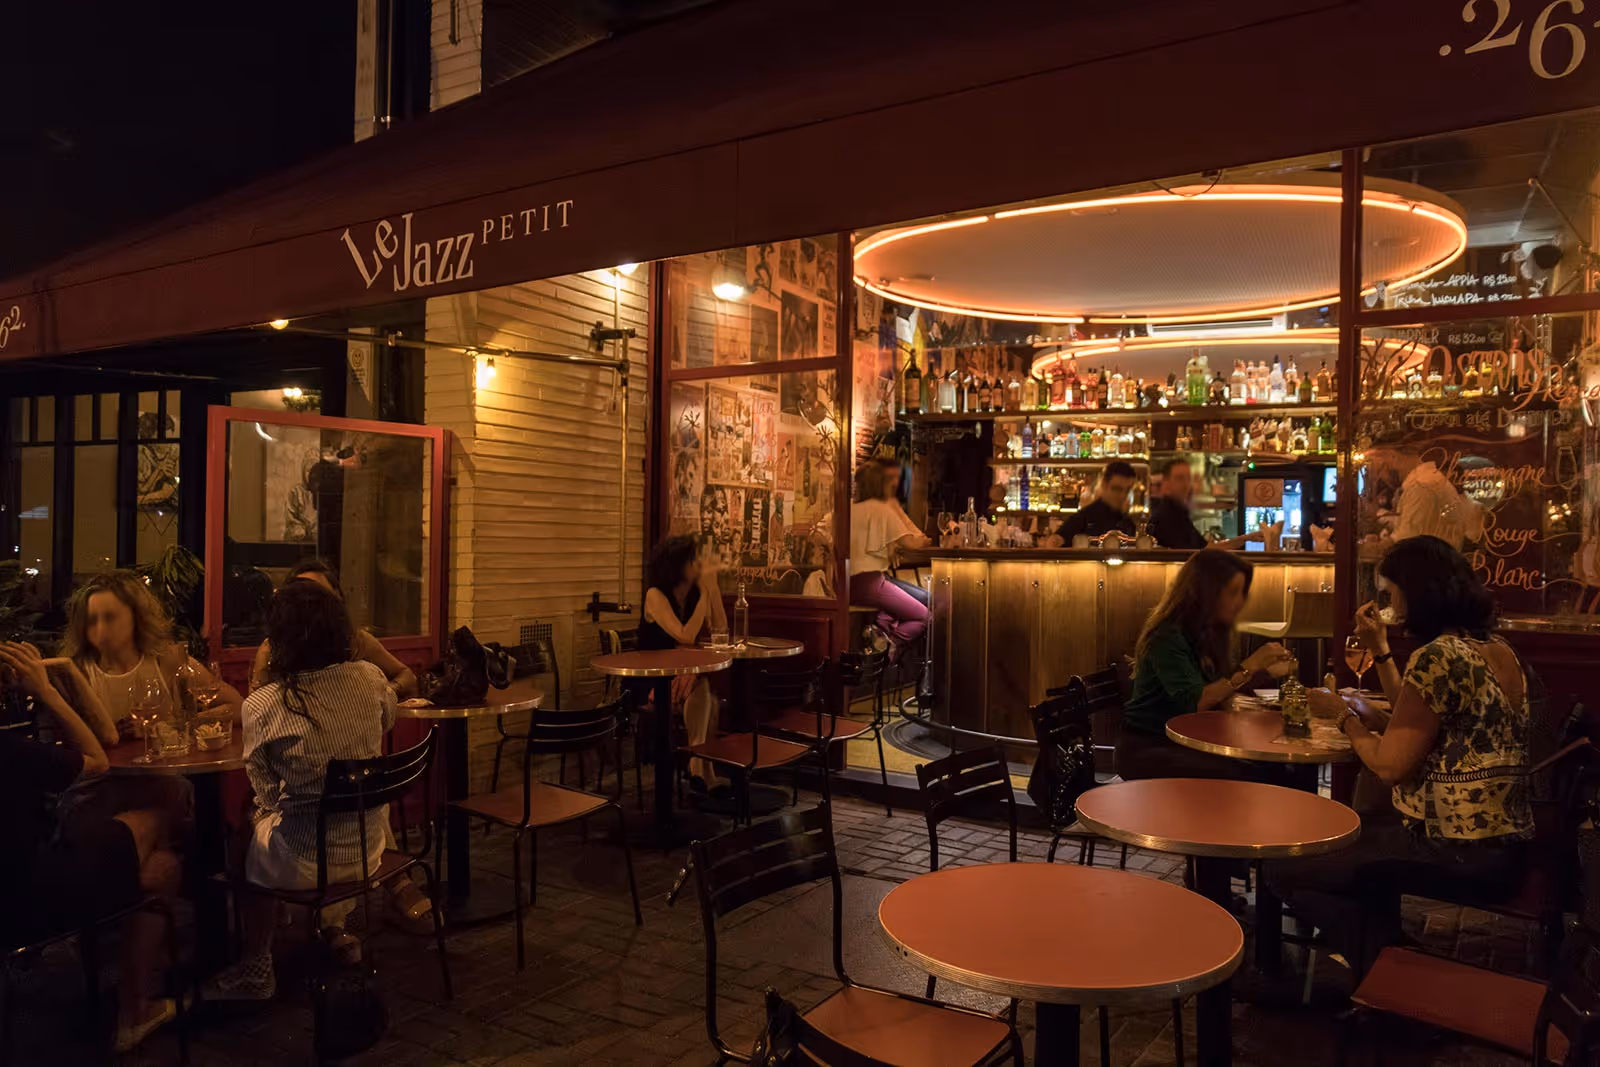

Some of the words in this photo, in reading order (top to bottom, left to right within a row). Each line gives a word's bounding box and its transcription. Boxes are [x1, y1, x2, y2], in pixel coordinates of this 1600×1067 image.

[481, 199, 574, 245] PETIT
[1478, 510, 1540, 557] Rouge
[1470, 550, 1542, 591] Blanc
